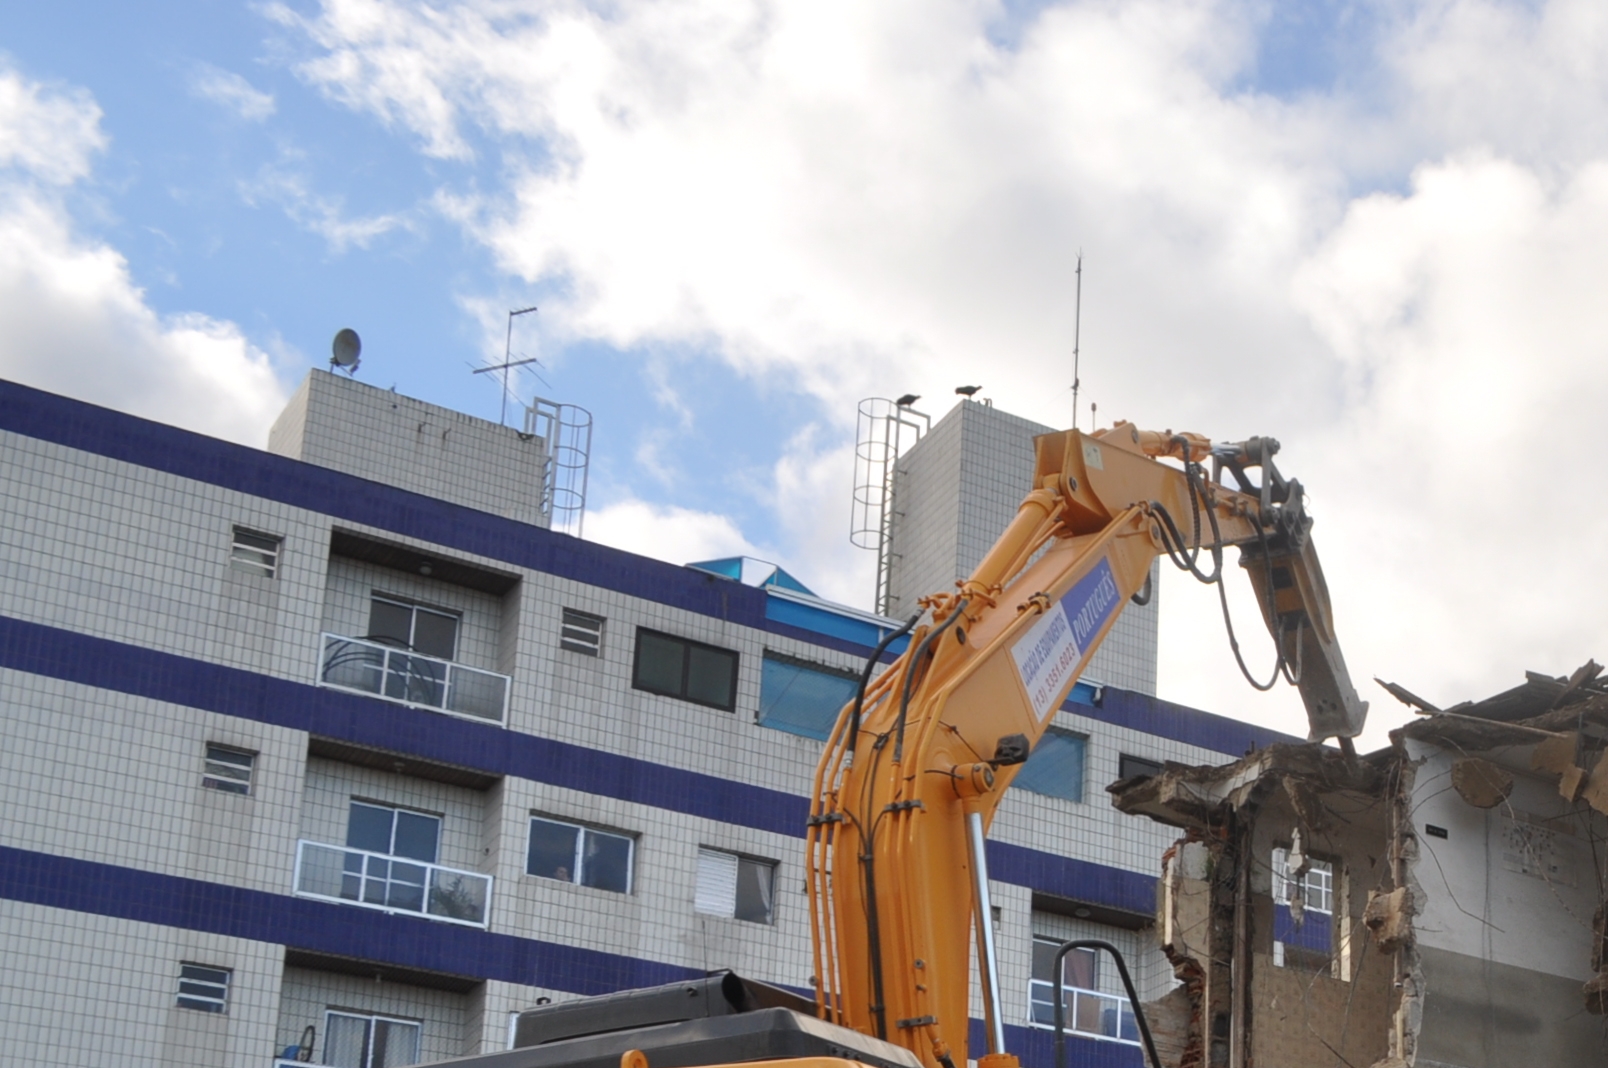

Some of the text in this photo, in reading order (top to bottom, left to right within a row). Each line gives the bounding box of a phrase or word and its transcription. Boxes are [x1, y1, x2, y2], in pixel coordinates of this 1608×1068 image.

[1072, 570, 1116, 645] PORTUGUÊS
[1033, 642, 1076, 716] (13) 3351.6023
